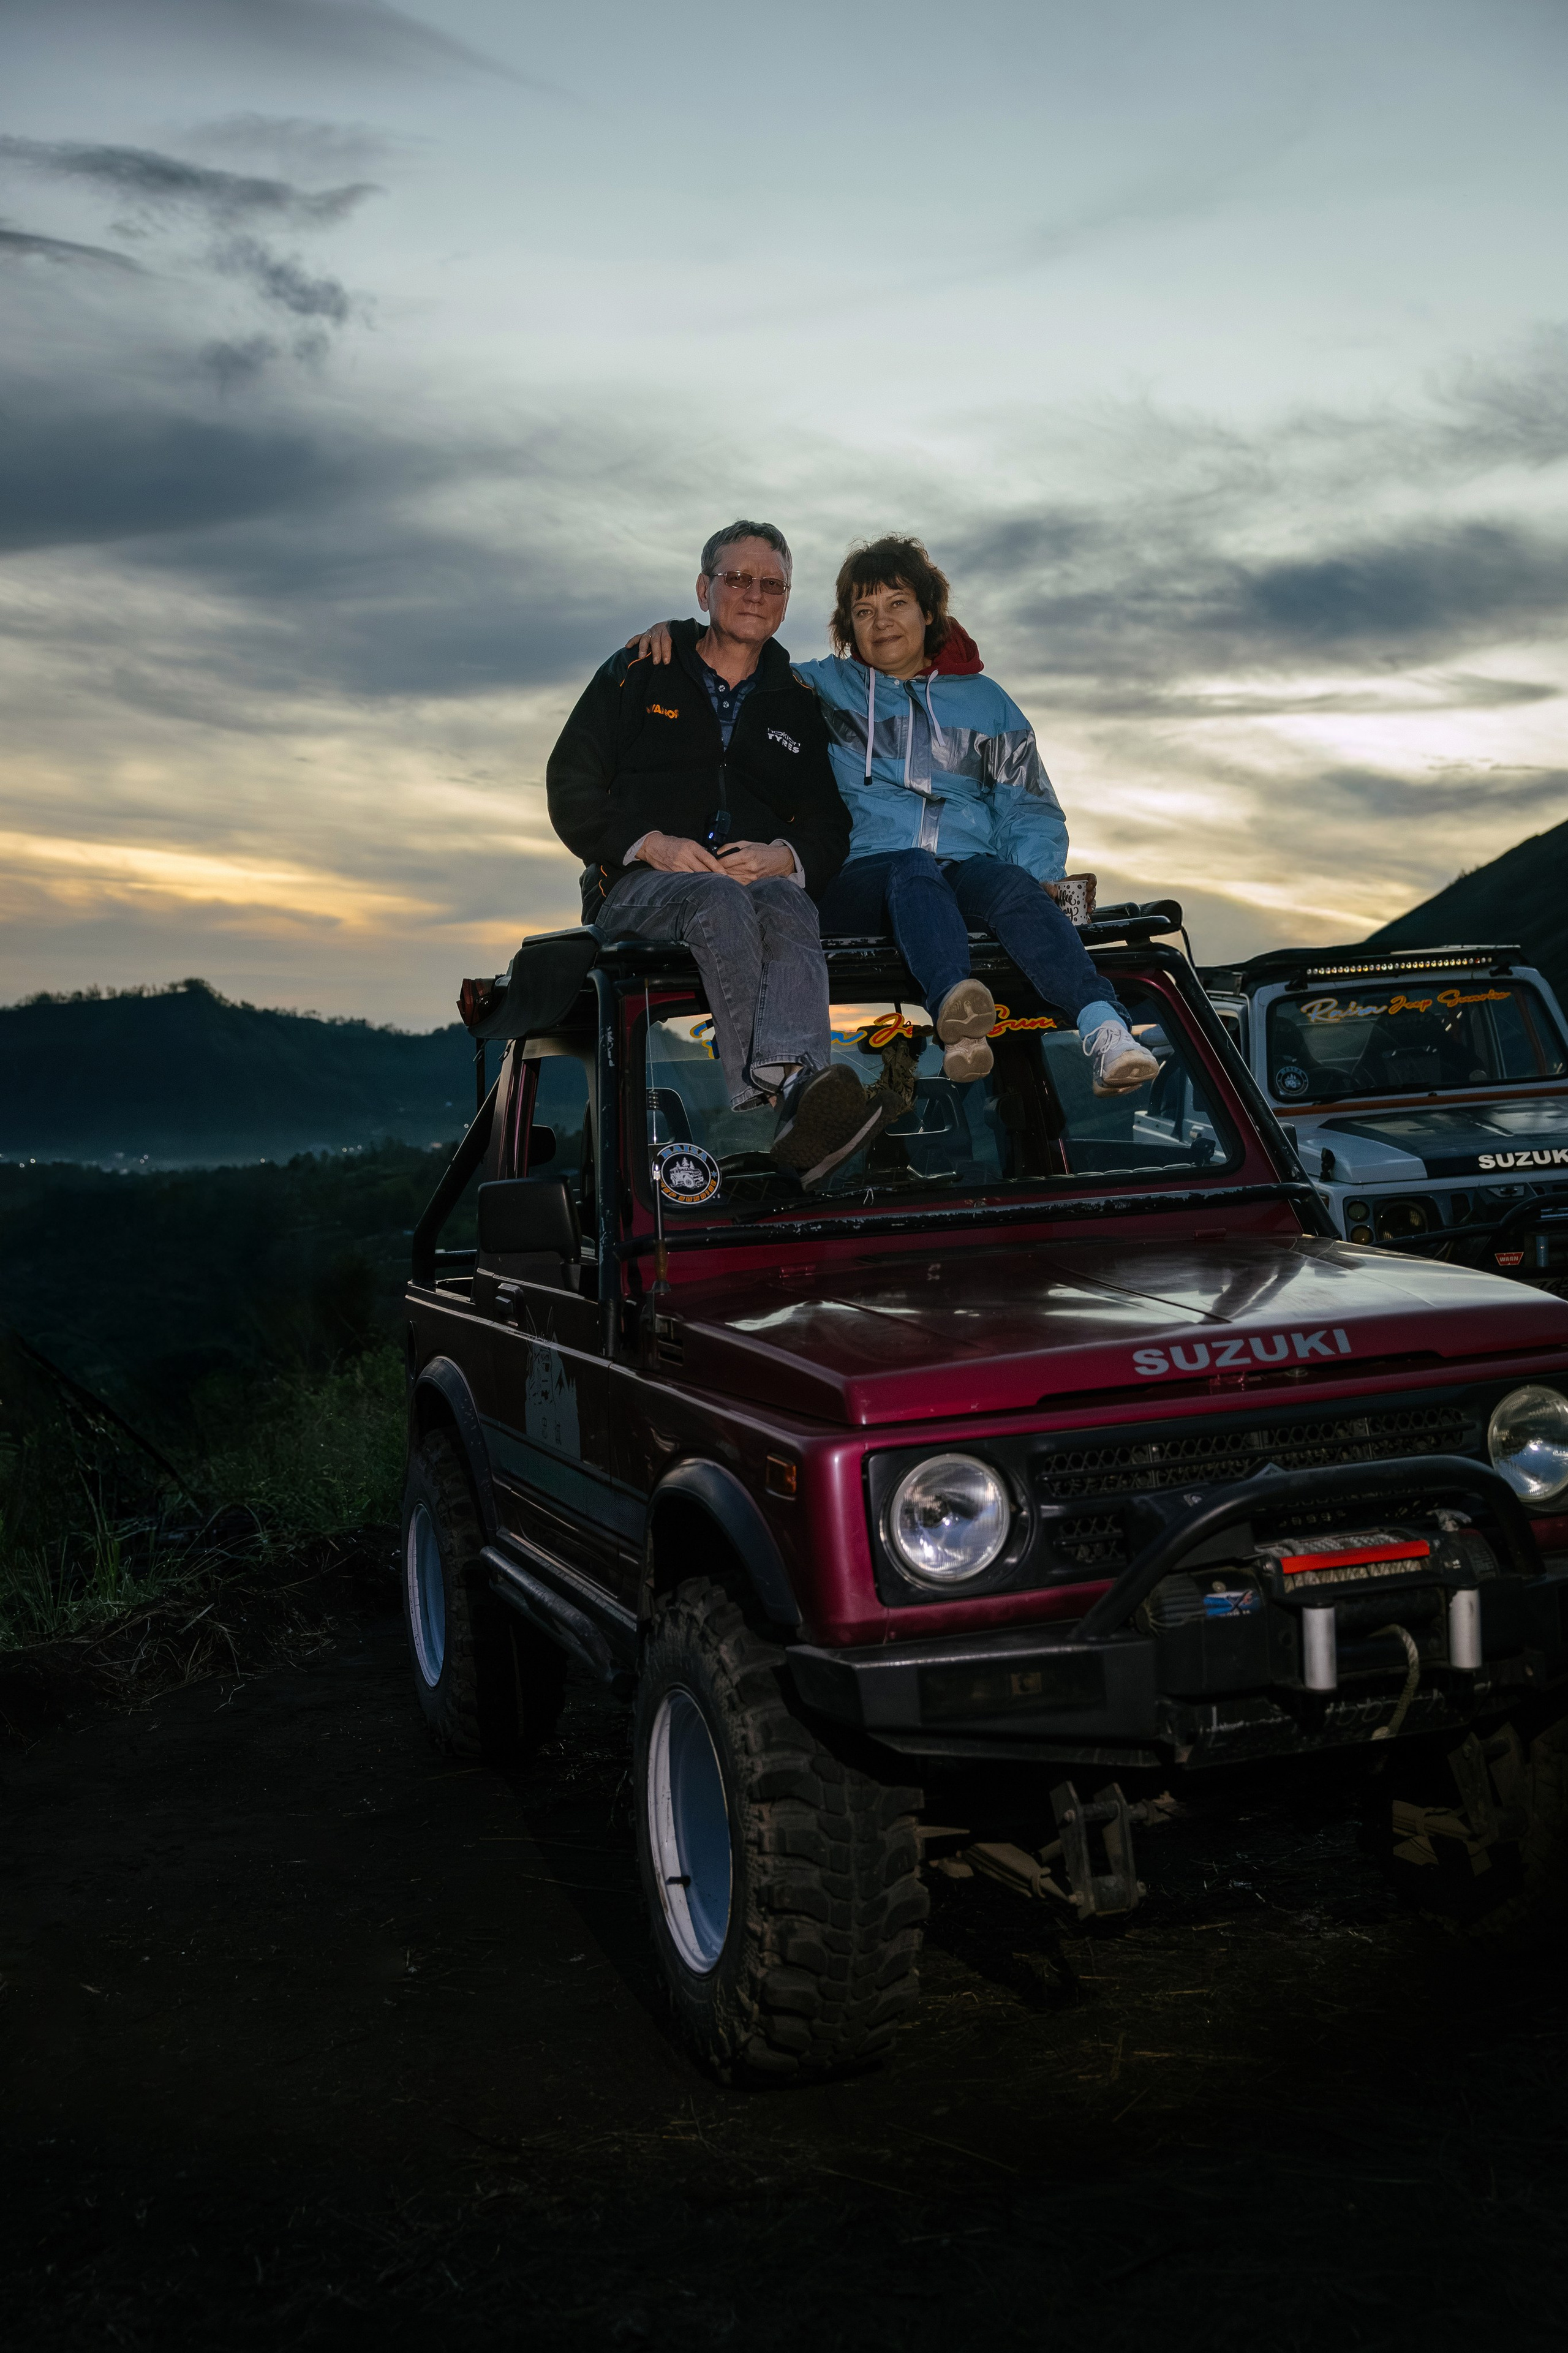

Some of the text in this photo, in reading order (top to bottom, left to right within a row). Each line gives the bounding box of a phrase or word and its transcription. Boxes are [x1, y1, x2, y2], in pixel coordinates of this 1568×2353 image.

[767, 732, 799, 753] TYRES
[1058, 889, 1077, 906] ffee
[1063, 906, 1079, 921] ay
[1388, 995, 1433, 1015] Jeep
[660, 1145, 707, 1162] RAISA
[1478, 1148, 1568, 1169] SUZUK
[660, 1179, 717, 1203] EEP SUNRISE
[1132, 1328, 1352, 1376] SUZUKI
